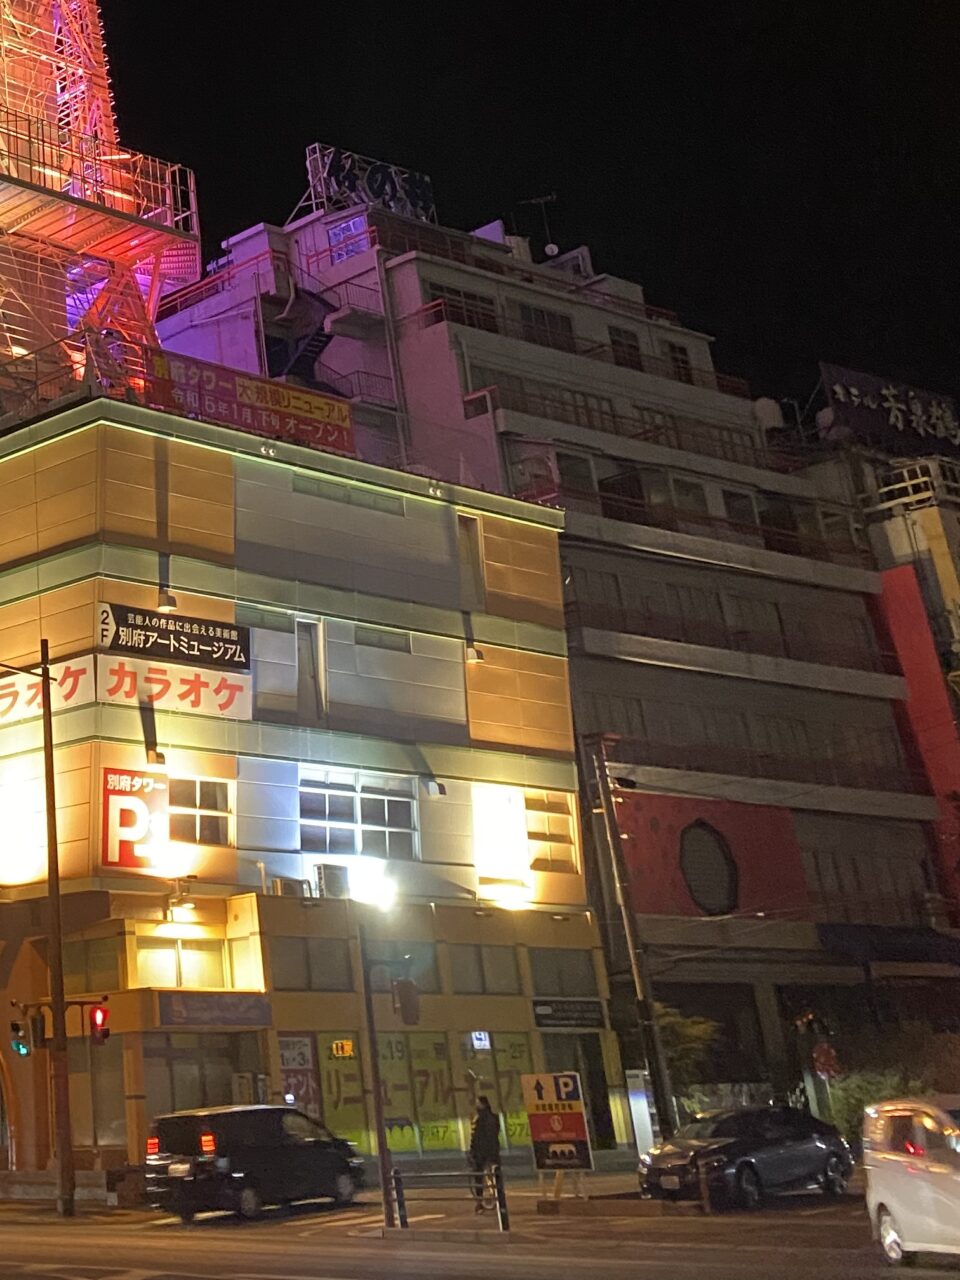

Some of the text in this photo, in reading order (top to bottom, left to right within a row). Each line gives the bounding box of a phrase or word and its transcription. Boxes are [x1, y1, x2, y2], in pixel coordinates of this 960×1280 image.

[127, 612, 239, 641] 芸能人の作品に出会える美術館
[118, 626, 246, 663] 別府アートミュージアム
[106, 662, 244, 712] カラオケ
[107, 774, 167, 793] 別府タワー
[559, 1078, 573, 1099] P
